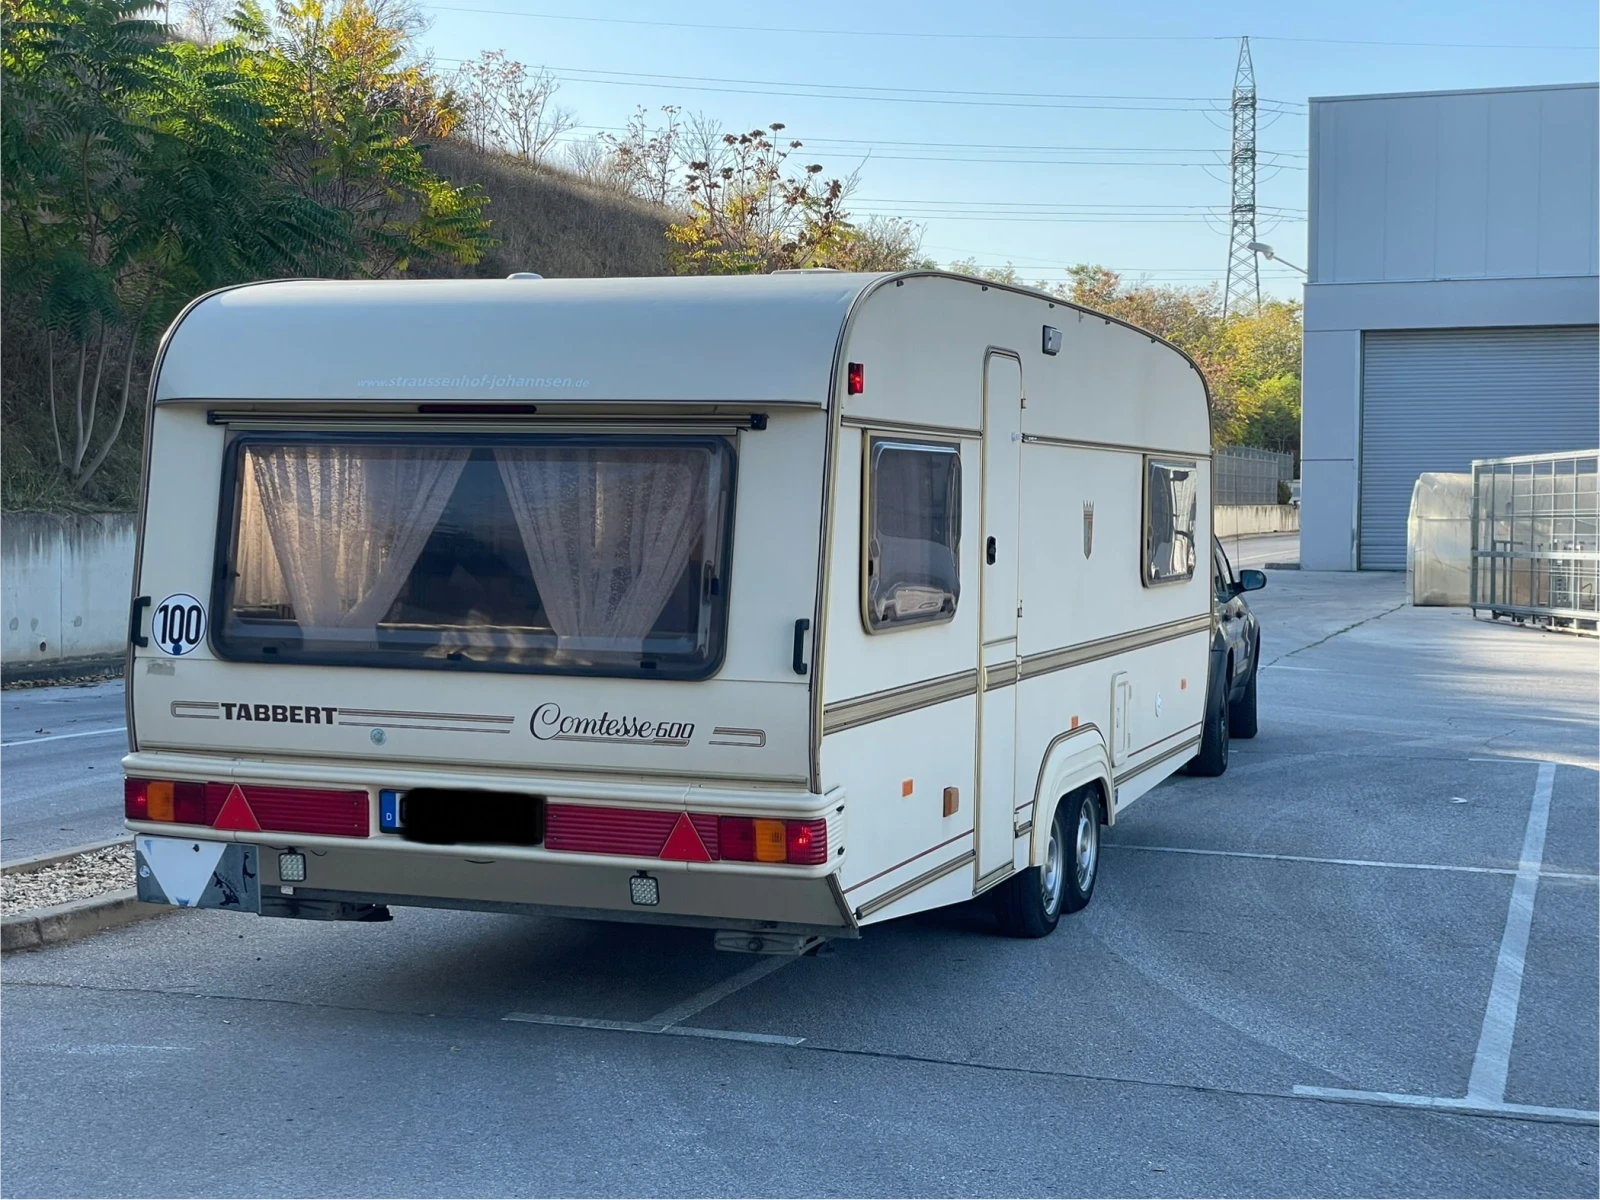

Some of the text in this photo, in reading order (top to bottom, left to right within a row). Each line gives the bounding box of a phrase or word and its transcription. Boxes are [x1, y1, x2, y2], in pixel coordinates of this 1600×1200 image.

[357, 374, 590, 389] www.straussenhof-johannsen.de
[159, 604, 202, 645] 100
[221, 703, 338, 725] TABBERT
[386, 812, 392, 821] D
